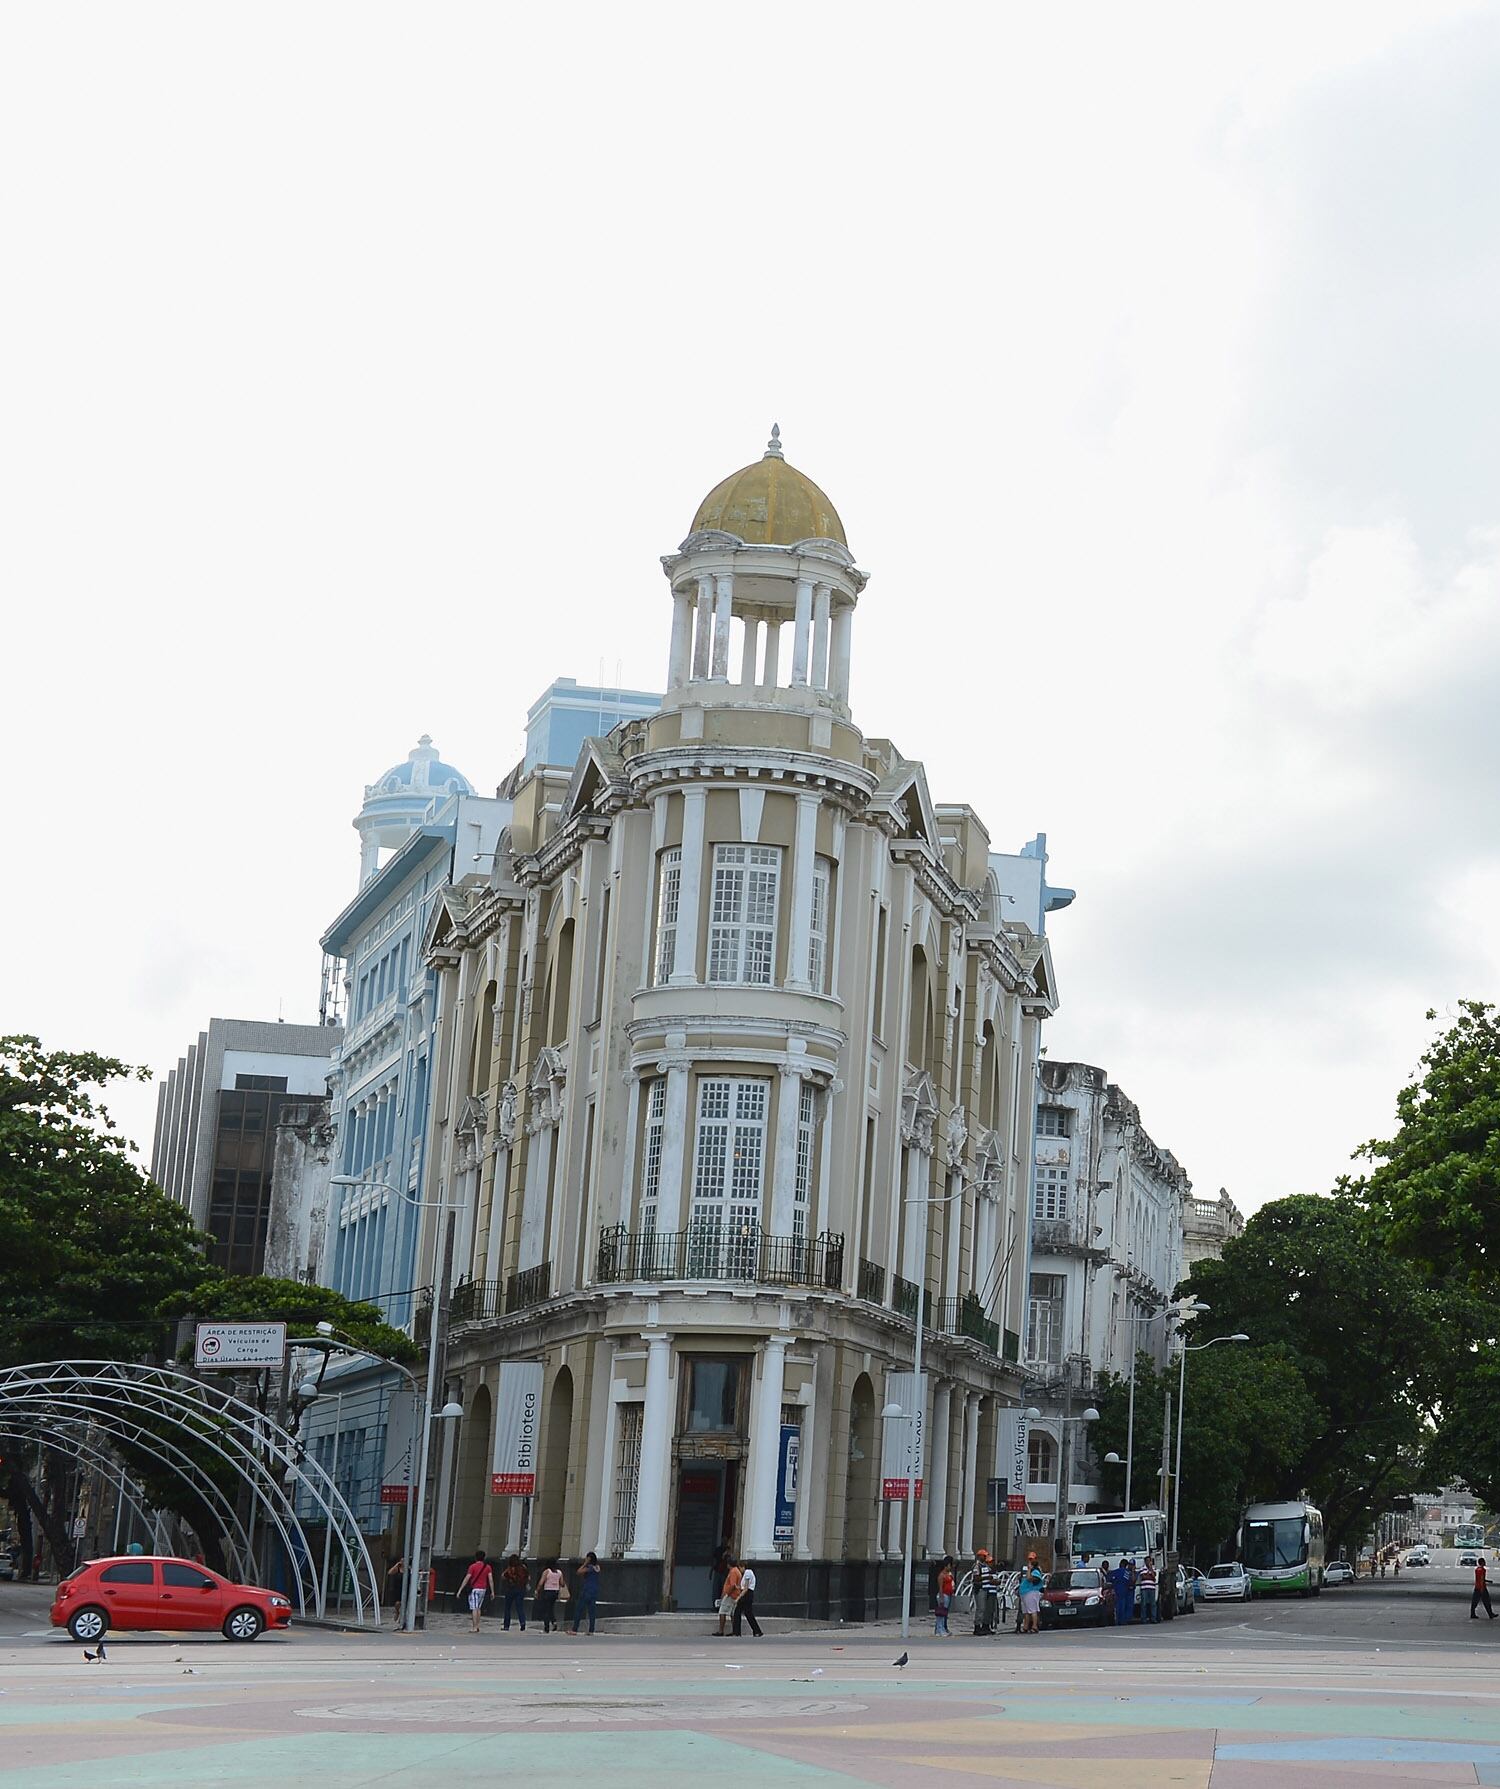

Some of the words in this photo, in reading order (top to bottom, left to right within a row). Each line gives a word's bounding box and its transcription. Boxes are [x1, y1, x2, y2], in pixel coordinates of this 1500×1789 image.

[518, 1393, 535, 1467] Biblioteca
[1015, 1416, 1027, 1456] Visuais
[1013, 1459, 1024, 1490] Artes
